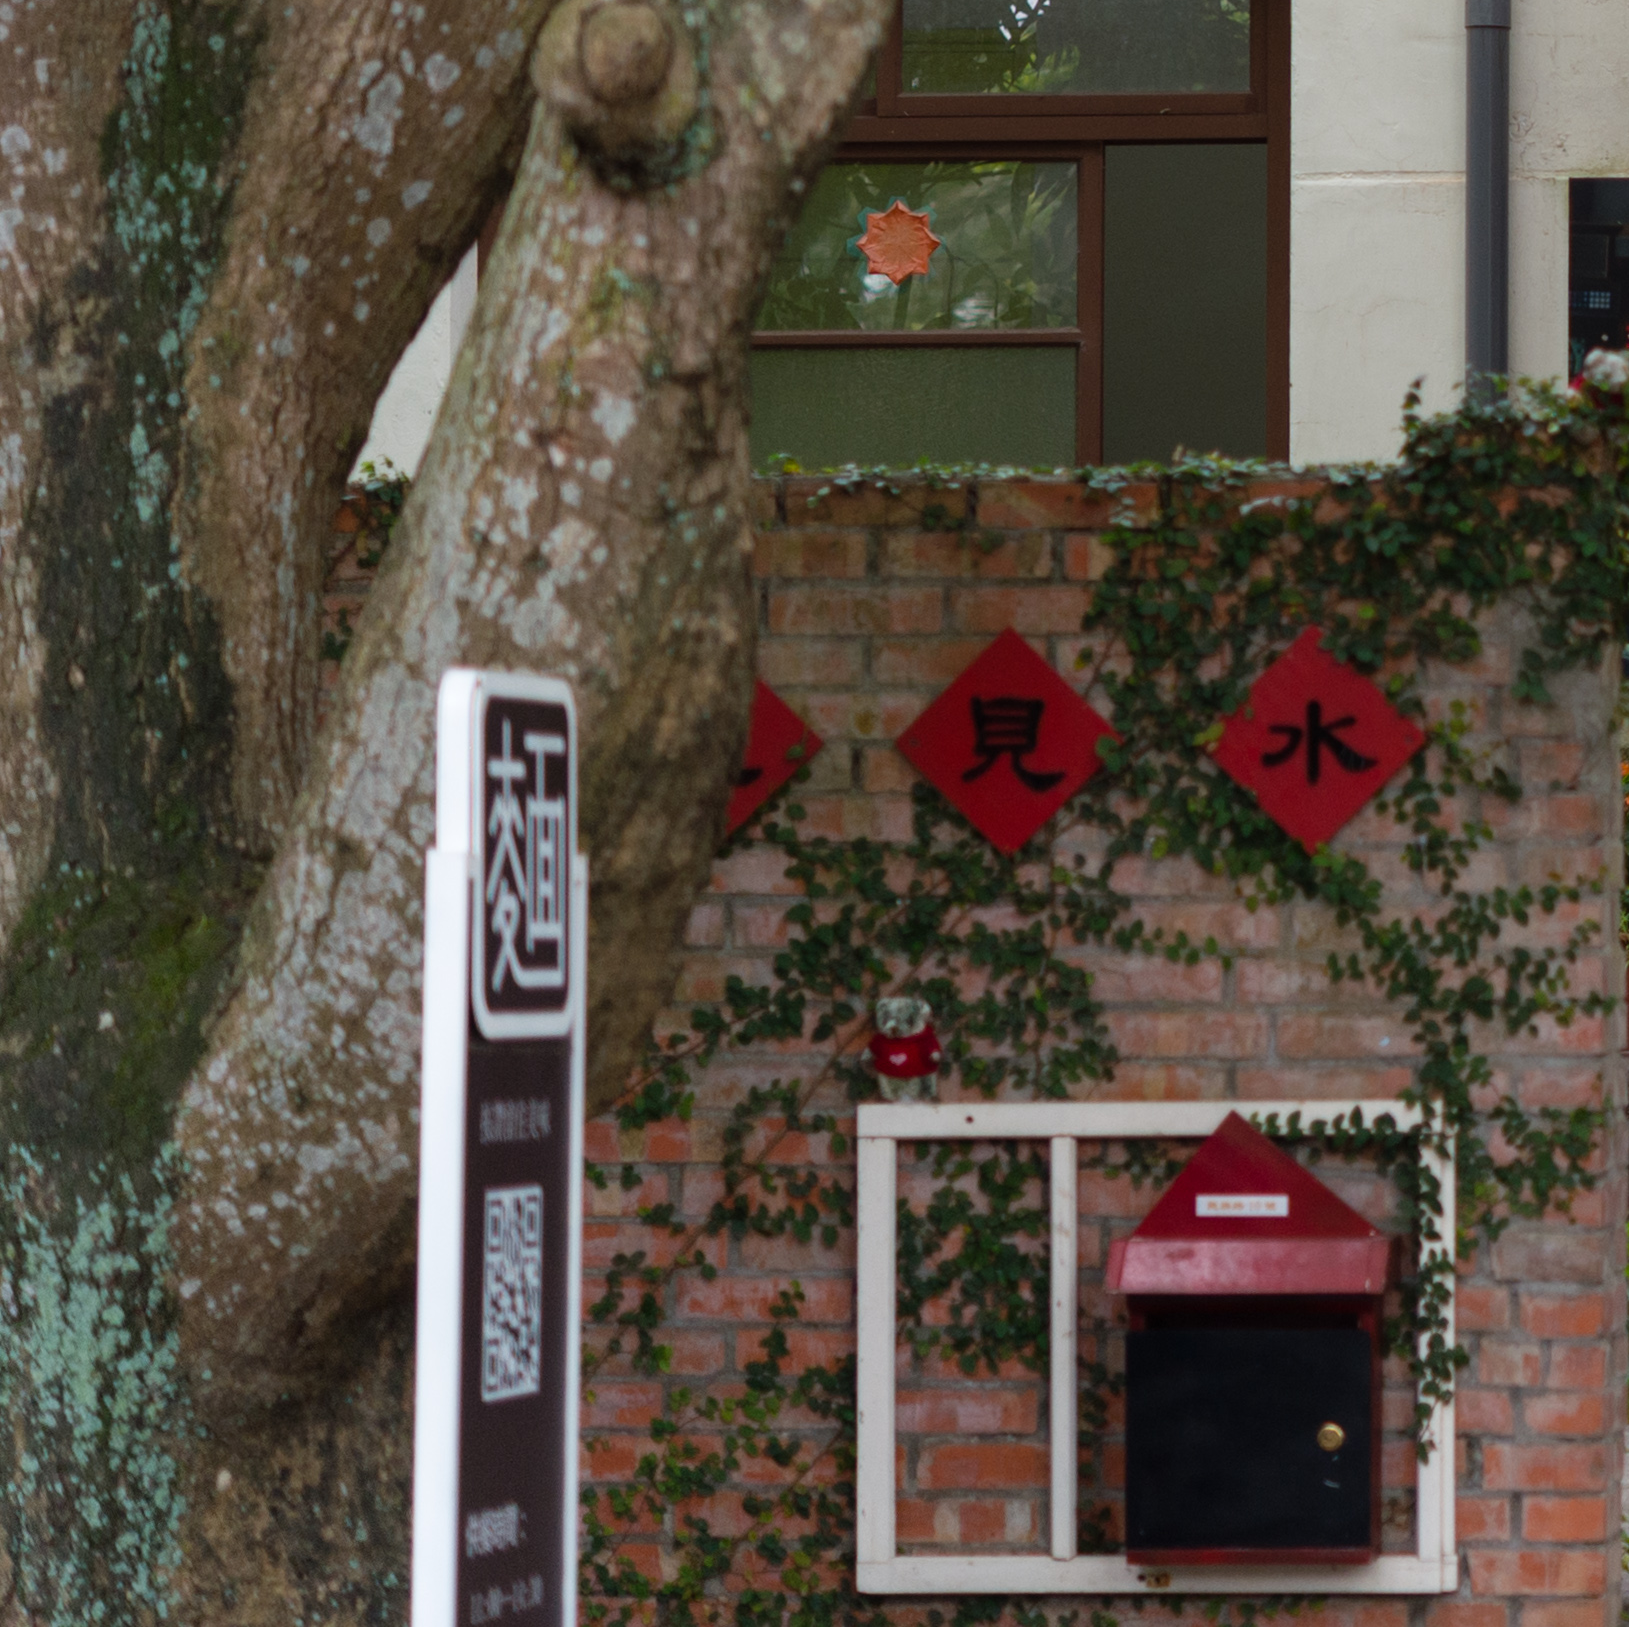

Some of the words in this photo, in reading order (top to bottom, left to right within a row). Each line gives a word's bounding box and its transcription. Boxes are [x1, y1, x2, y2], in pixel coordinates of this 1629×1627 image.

[962, 696, 1065, 793] 見
[1261, 699, 1378, 786] 水
[486, 717, 567, 991] 麵
